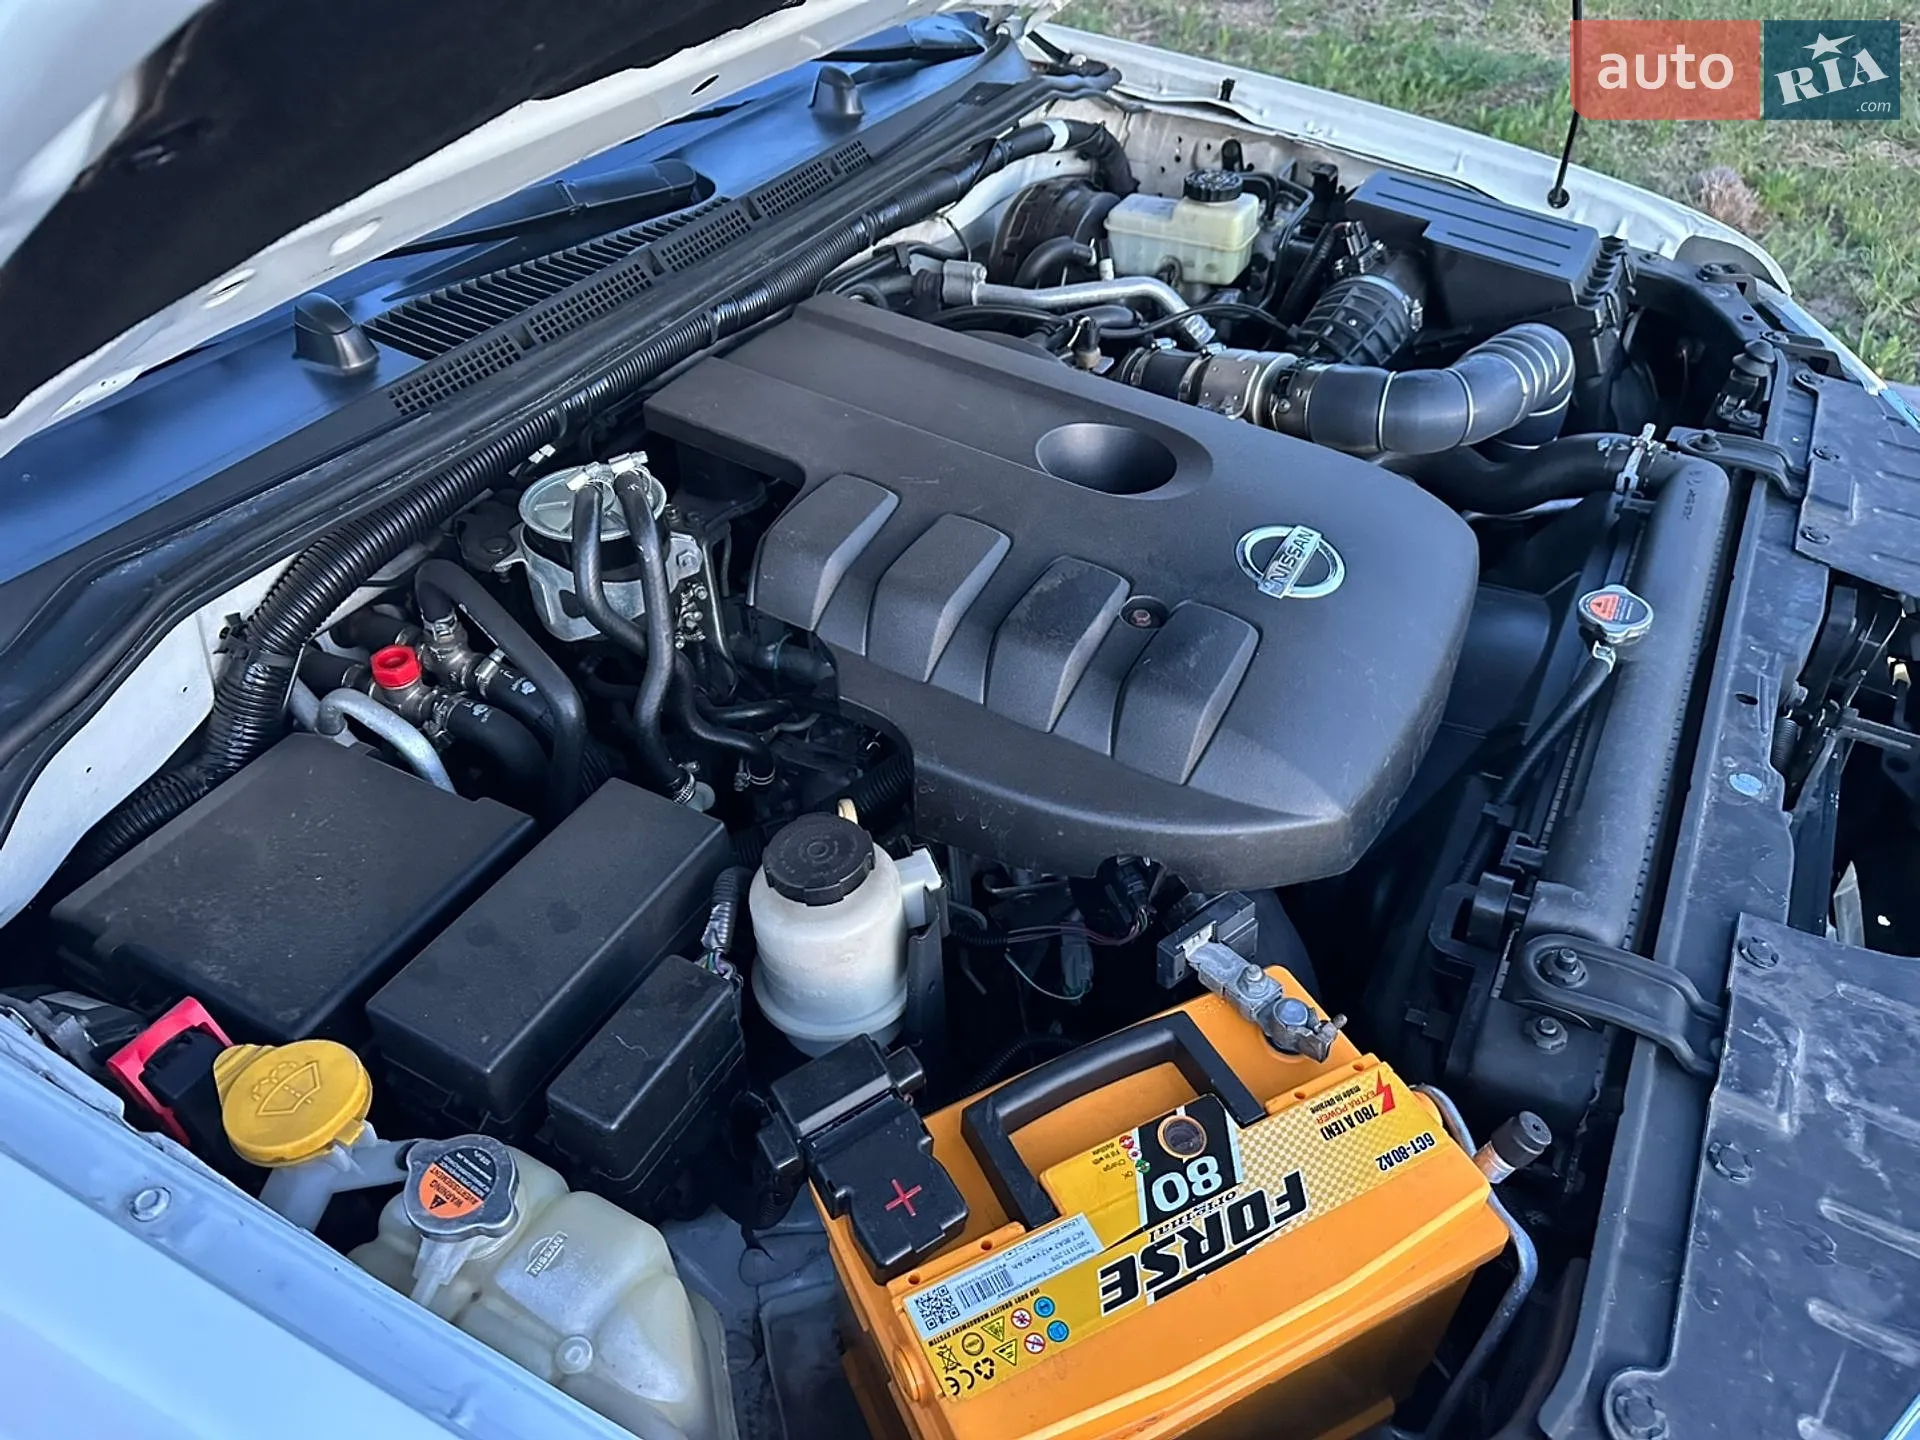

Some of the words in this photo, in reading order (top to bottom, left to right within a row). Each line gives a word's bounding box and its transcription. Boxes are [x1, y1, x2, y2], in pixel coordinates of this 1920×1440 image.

[1267, 528, 1315, 588] NISSAN
[1336, 1093, 1342, 1102] in
[1343, 1085, 1360, 1098] made
[1348, 1090, 1376, 1108] EXTRA
[1310, 1097, 1335, 1114] Ukraine
[1317, 1105, 1347, 1124] POWER
[1357, 1104, 1378, 1124] 780
[1344, 1114, 1355, 1128] A
[1102, 1158, 1126, 1172] Charge
[1121, 1170, 1134, 1179] OK
[1152, 1155, 1222, 1212] 80
[429, 1179, 464, 1208] WARNING
[1148, 1190, 1237, 1242] original
[1098, 1170, 1308, 1314] FORSE
[530, 1235, 564, 1275] NISSAN
[990, 1300, 1013, 1316] QUALITY
[952, 1313, 988, 1335] MANAGEMENT
[928, 1331, 951, 1347] SYSTEM
